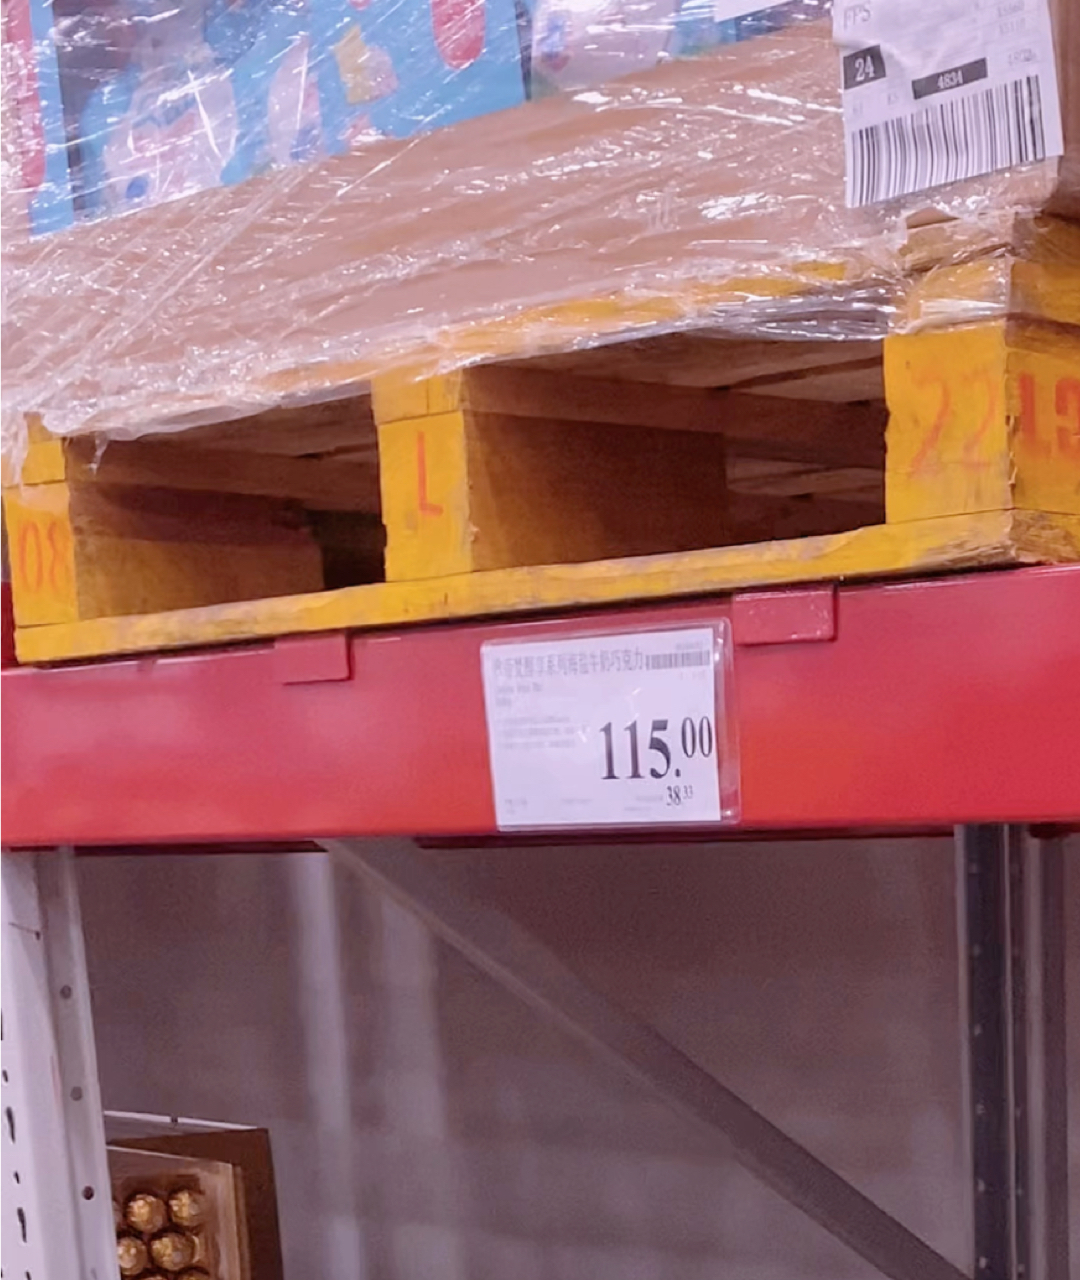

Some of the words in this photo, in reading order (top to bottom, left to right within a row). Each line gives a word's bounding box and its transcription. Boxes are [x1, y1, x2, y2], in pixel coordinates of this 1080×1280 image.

[855, 56, 875, 82] 24
[937, 70, 964, 89] 4834
[600, 716, 713, 780] 115.00
